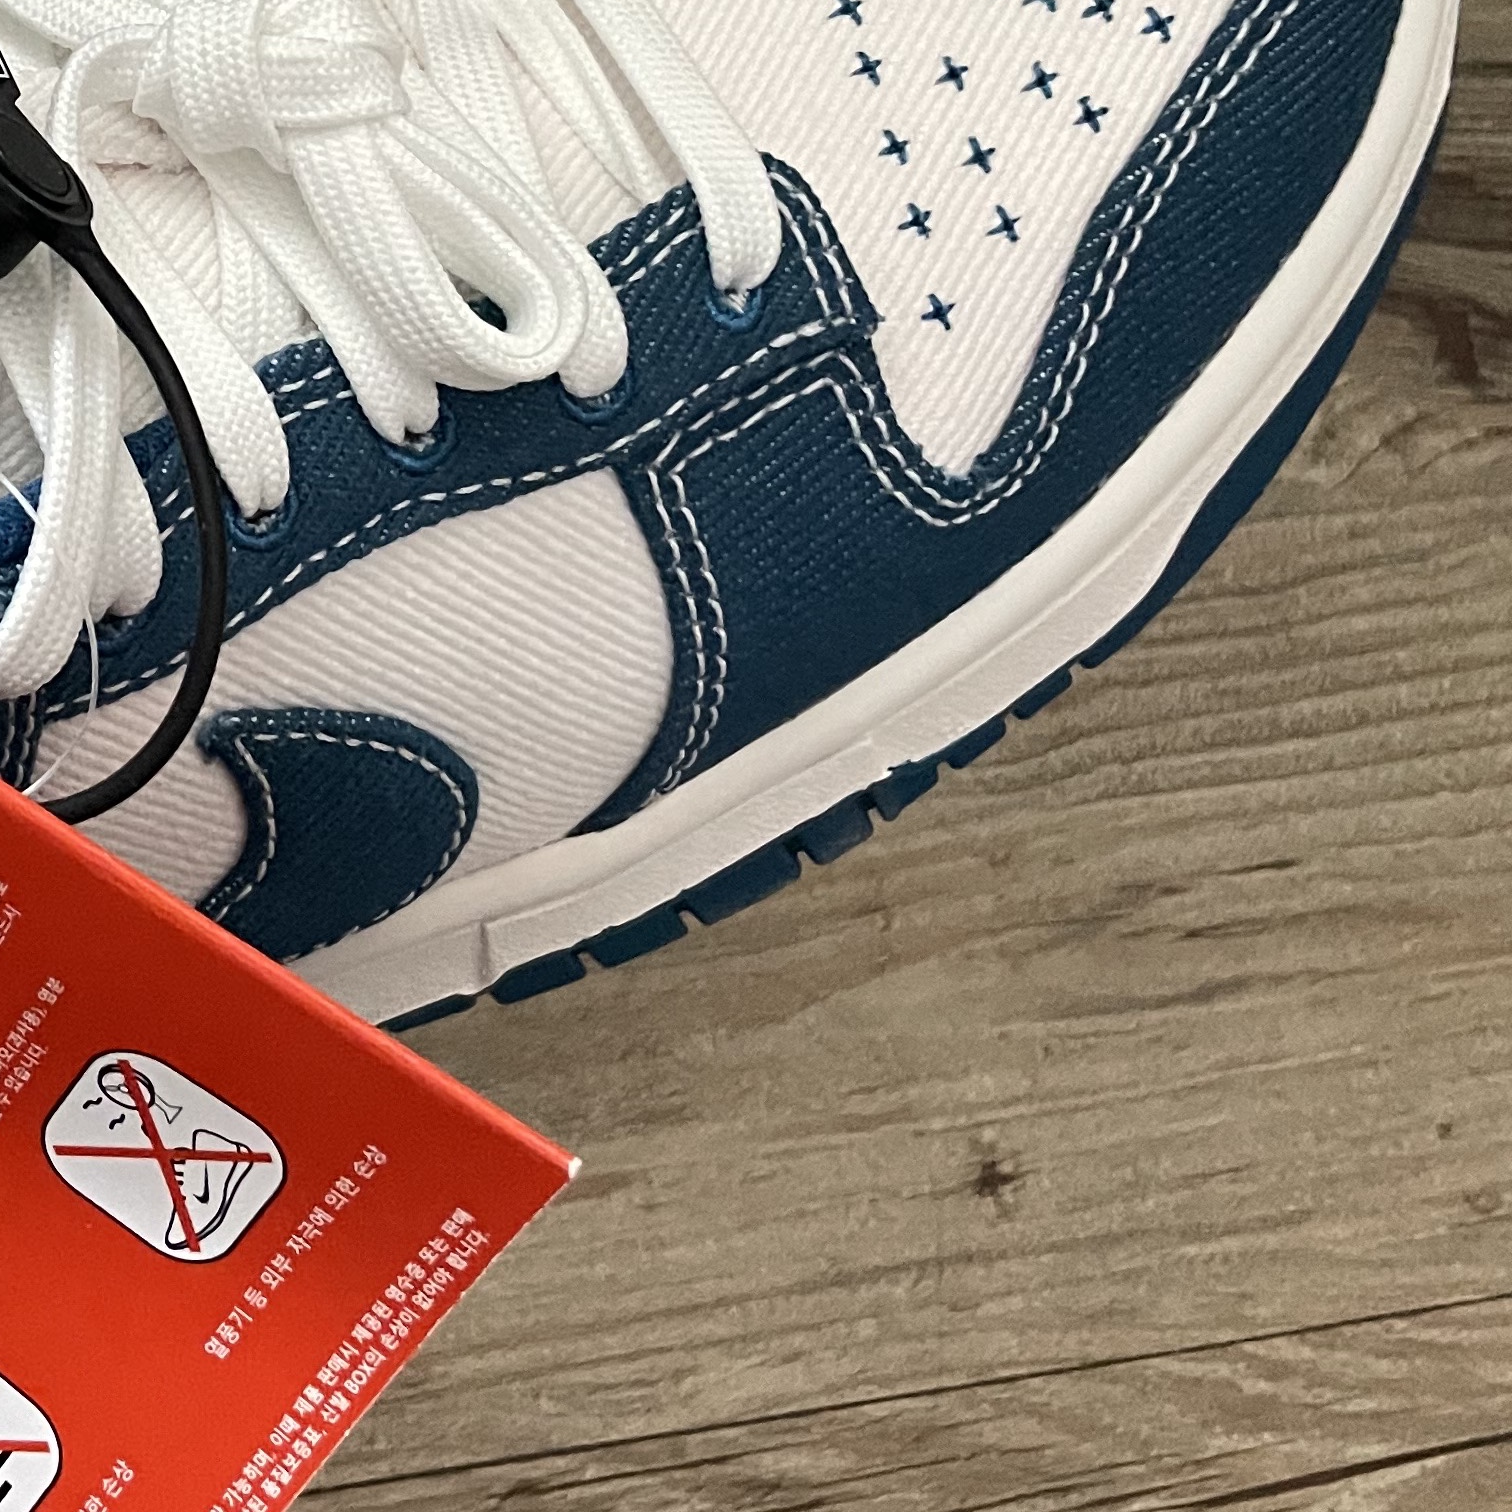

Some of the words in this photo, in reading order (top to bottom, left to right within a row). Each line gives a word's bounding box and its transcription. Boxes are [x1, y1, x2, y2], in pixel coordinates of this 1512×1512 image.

[203, 1305, 254, 1361] 열풍기
[243, 1286, 268, 1310] 등
[259, 1252, 294, 1291] 외부
[285, 1205, 336, 1256] 자극에
[324, 1175, 361, 1211] 의한
[353, 1144, 388, 1180] 손상
[292, 1383, 325, 1417] 제품
[384, 1261, 426, 1303] 영수증
[418, 1236, 450, 1265] 또는
[319, 1390, 351, 1425] 신발
[343, 1345, 387, 1395] BOX의
[380, 1306, 422, 1351] 손상이
[411, 1267, 455, 1311] 없어야
[101, 1458, 135, 1499] 손상
